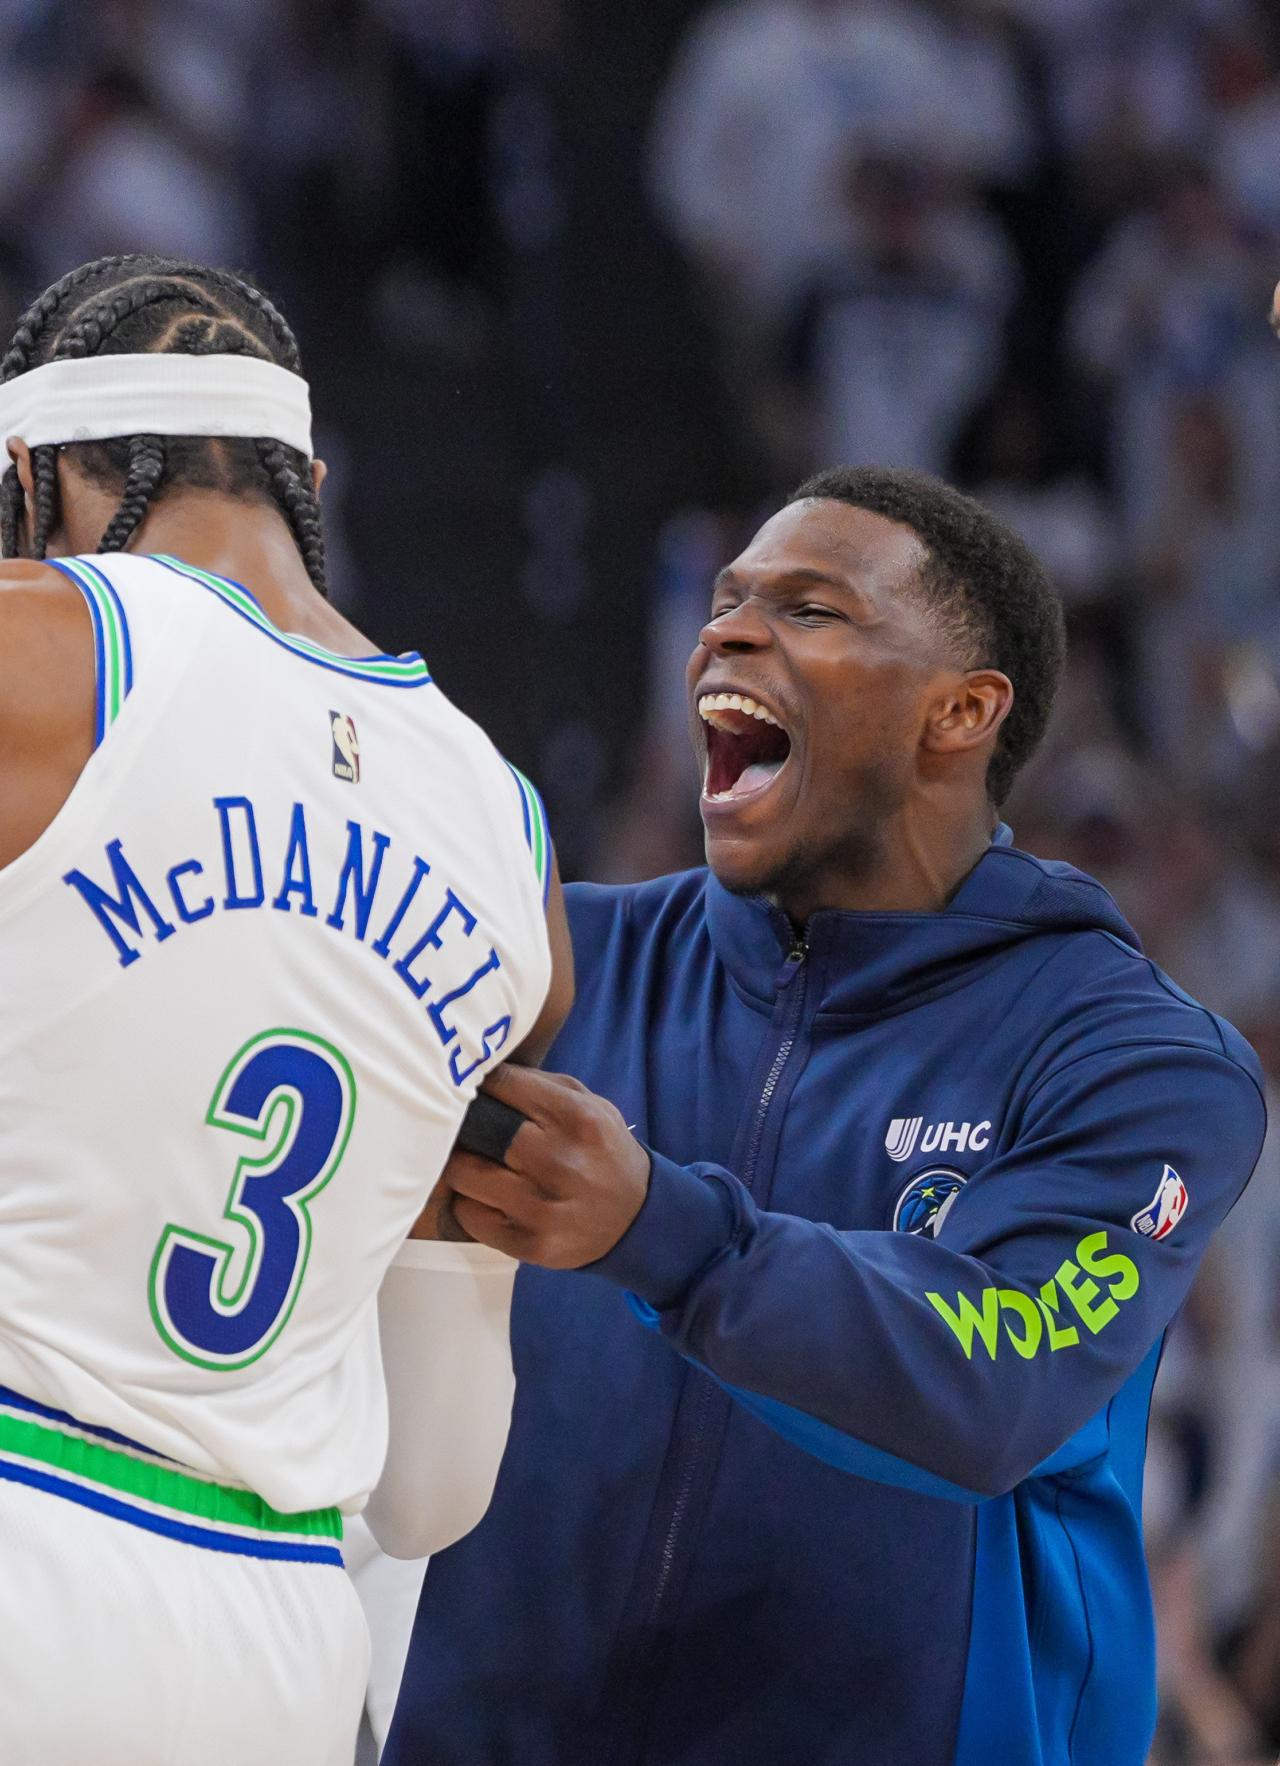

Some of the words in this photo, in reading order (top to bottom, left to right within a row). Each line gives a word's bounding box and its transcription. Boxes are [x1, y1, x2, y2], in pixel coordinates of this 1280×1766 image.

[62, 796, 511, 1087] McDANIELS
[147, 1027, 356, 1372] 3
[920, 1120, 992, 1152] UHC
